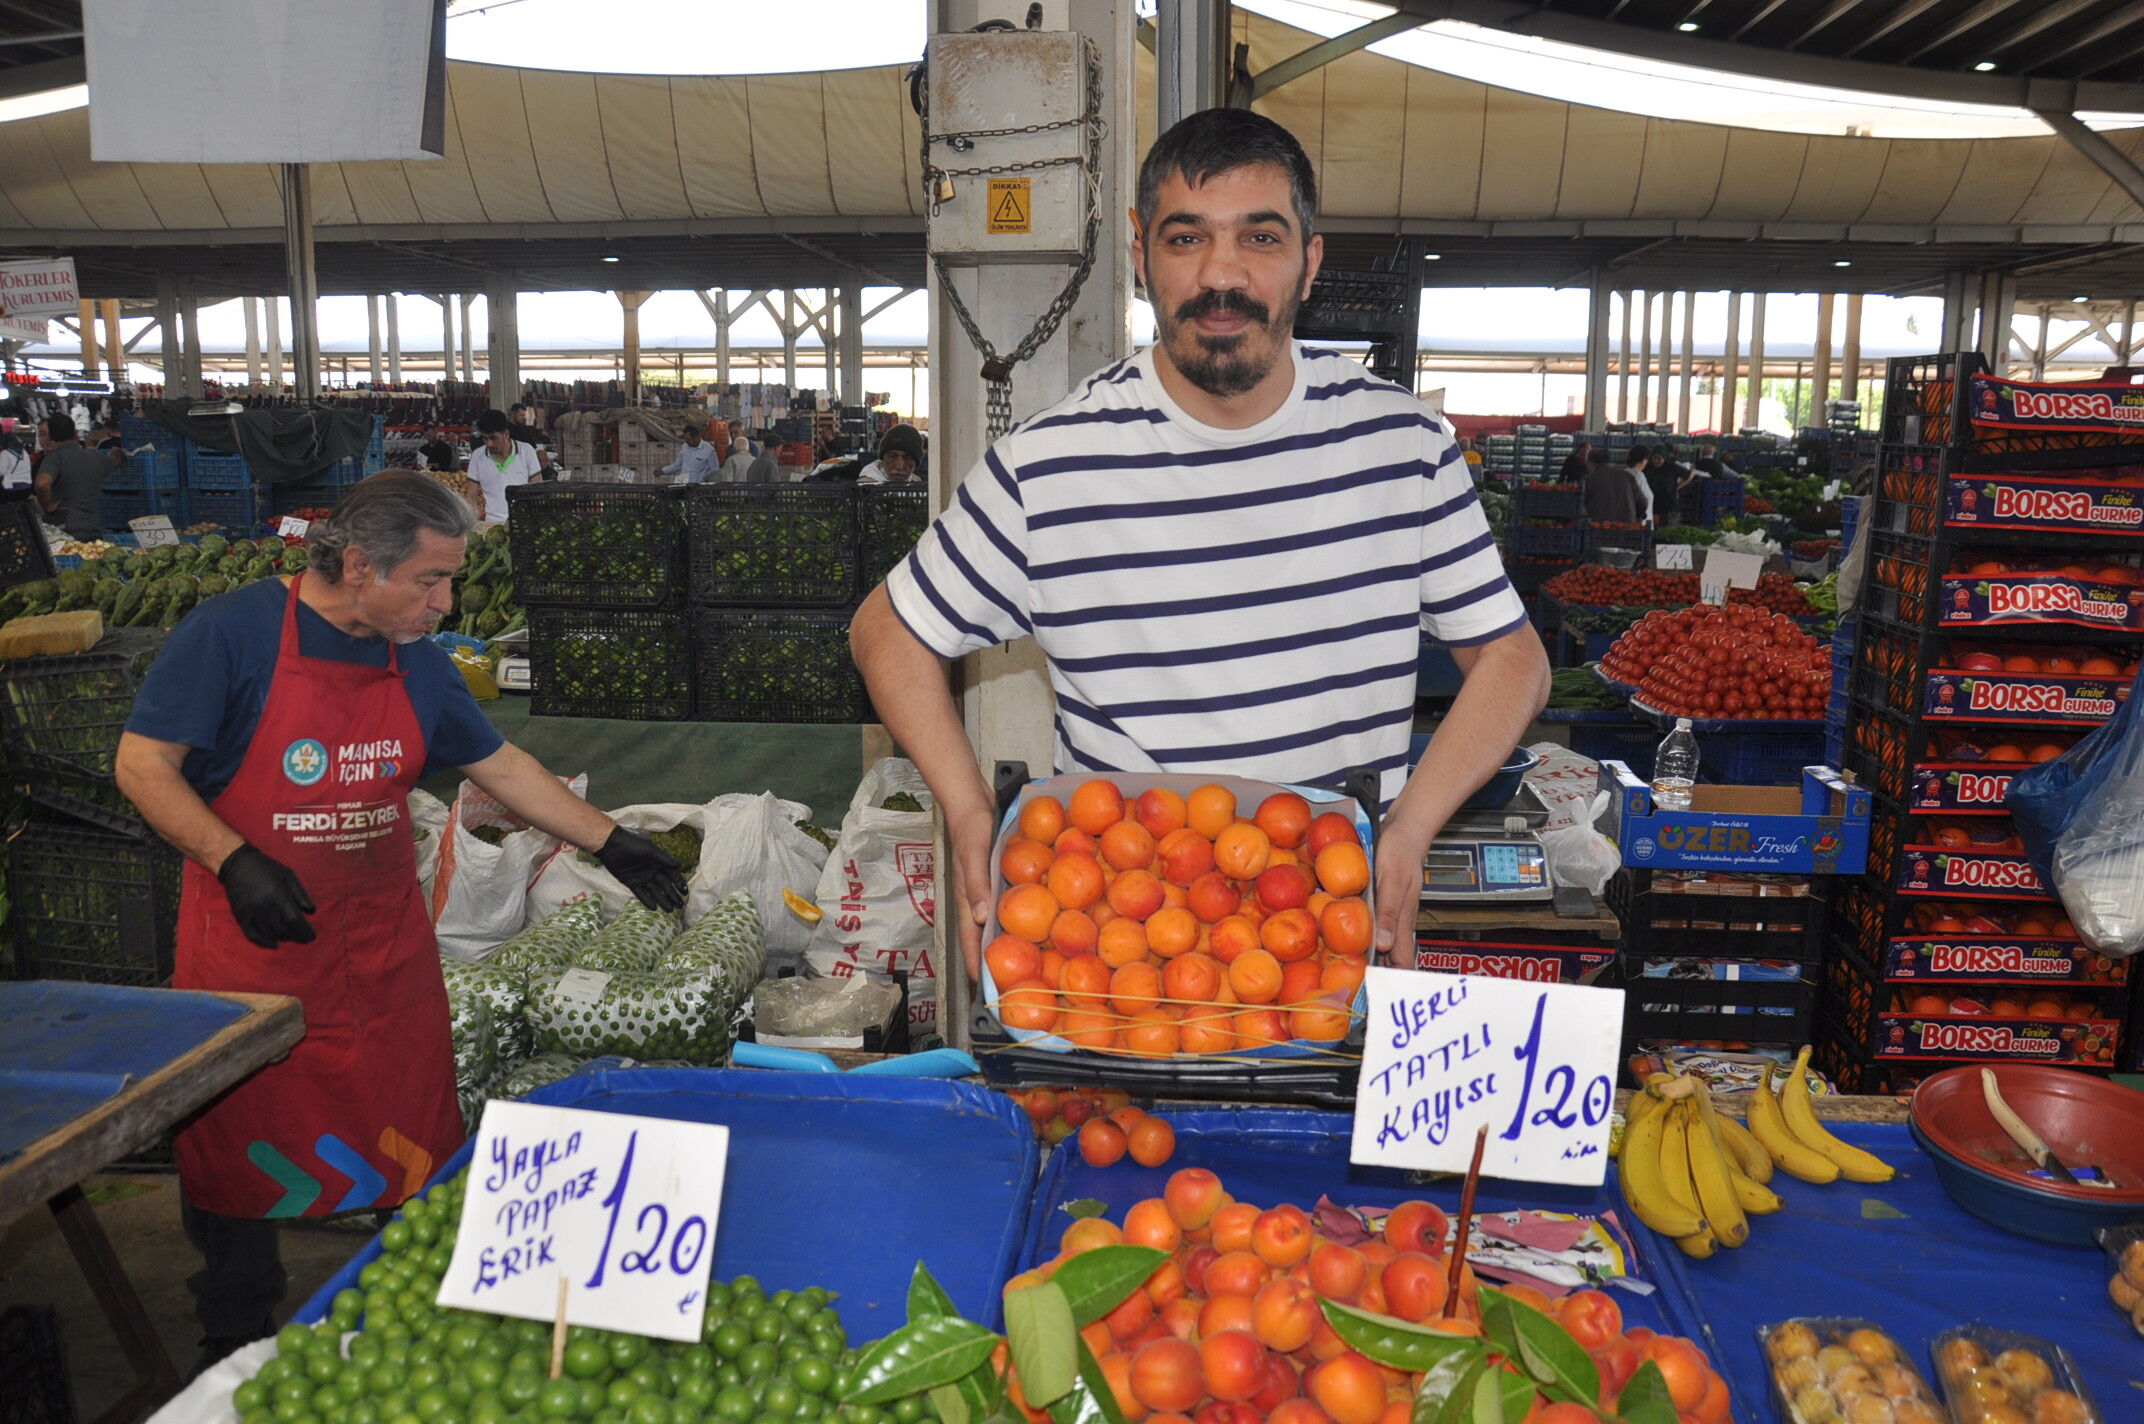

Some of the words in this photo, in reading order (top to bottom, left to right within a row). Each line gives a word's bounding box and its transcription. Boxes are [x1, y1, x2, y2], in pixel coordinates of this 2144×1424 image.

[340, 804, 400, 830] ZEYREK
[909, 853, 934, 862] TA
[1657, 824, 1752, 853] ÖZER
[1753, 836, 1805, 855] Fresh
[832, 943, 860, 979] YE
[876, 949, 937, 978] TA
[1418, 952, 1460, 970] GURM
[1369, 1022, 1491, 1097] TATLI
[1499, 992, 1612, 1141] 120
[486, 1130, 582, 1193] YAYLA
[496, 1167, 598, 1237] PAPAZ
[584, 1129, 707, 1288] 120
